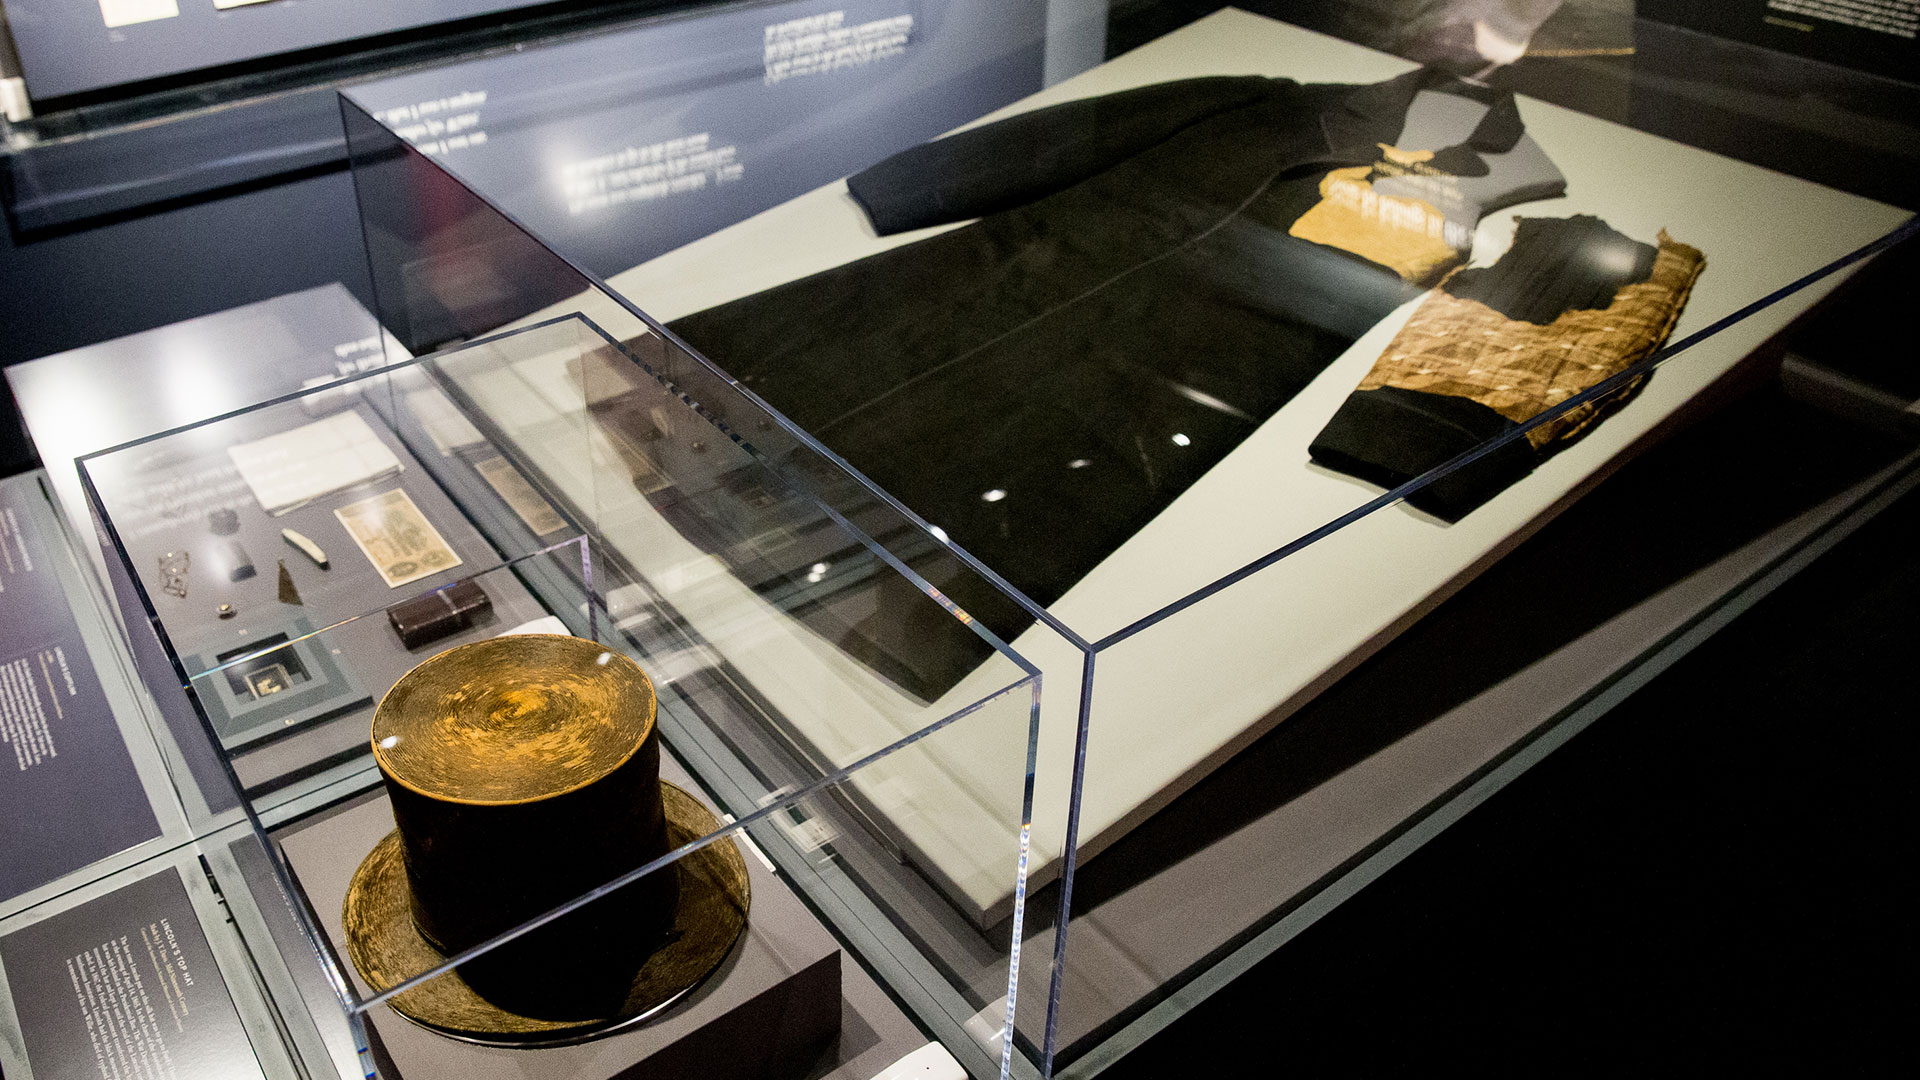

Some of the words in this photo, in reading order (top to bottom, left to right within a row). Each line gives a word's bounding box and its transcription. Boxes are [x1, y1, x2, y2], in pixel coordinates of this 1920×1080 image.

[160, 918, 180, 955] LINCOLN'S
[175, 956, 187, 971] TOP
[182, 972, 194, 986] HAT
[129, 963, 141, 980] Lincoln
[122, 975, 133, 988] April
